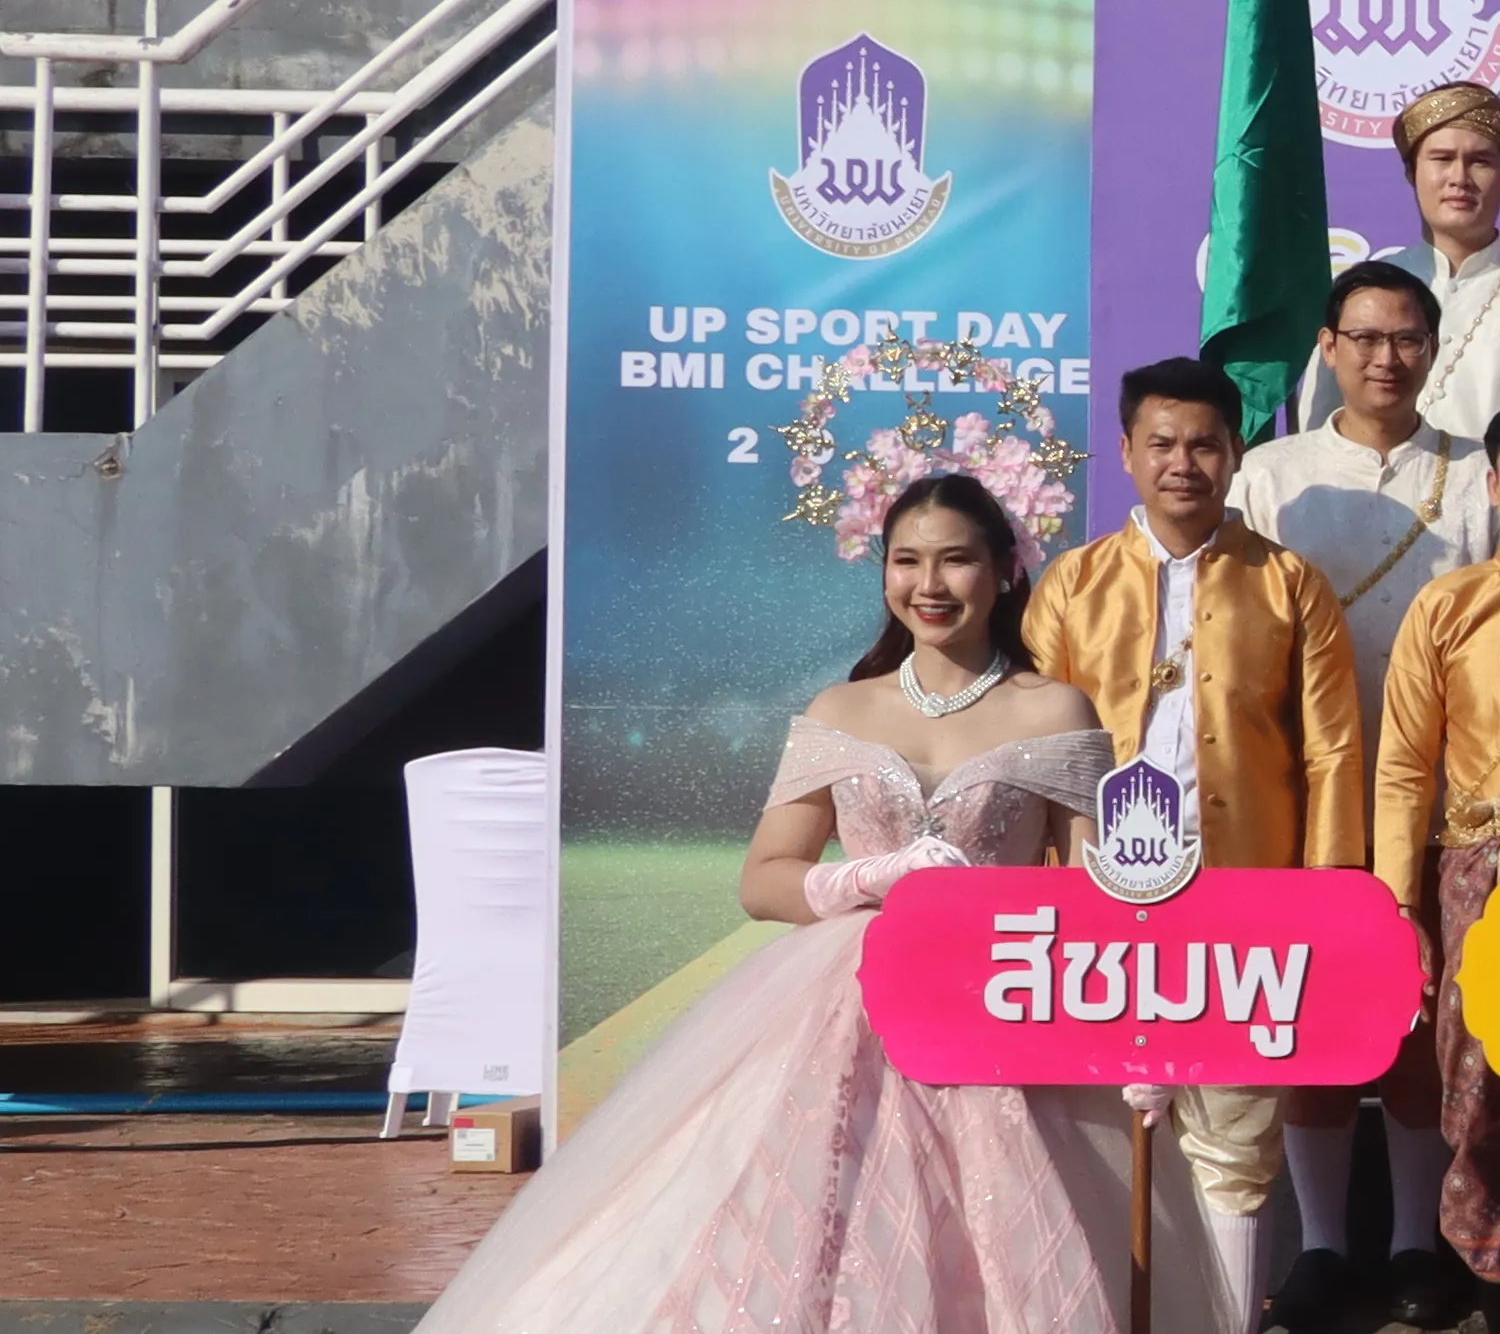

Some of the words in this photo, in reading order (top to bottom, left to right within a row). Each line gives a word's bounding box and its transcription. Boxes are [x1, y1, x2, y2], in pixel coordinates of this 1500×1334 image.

[649, 306, 727, 343] UP
[745, 308, 938, 347] SPORT
[956, 311, 1068, 349] DAY
[620, 350, 725, 389] BMI
[984, 906, 1310, 1058] สีชมพู
